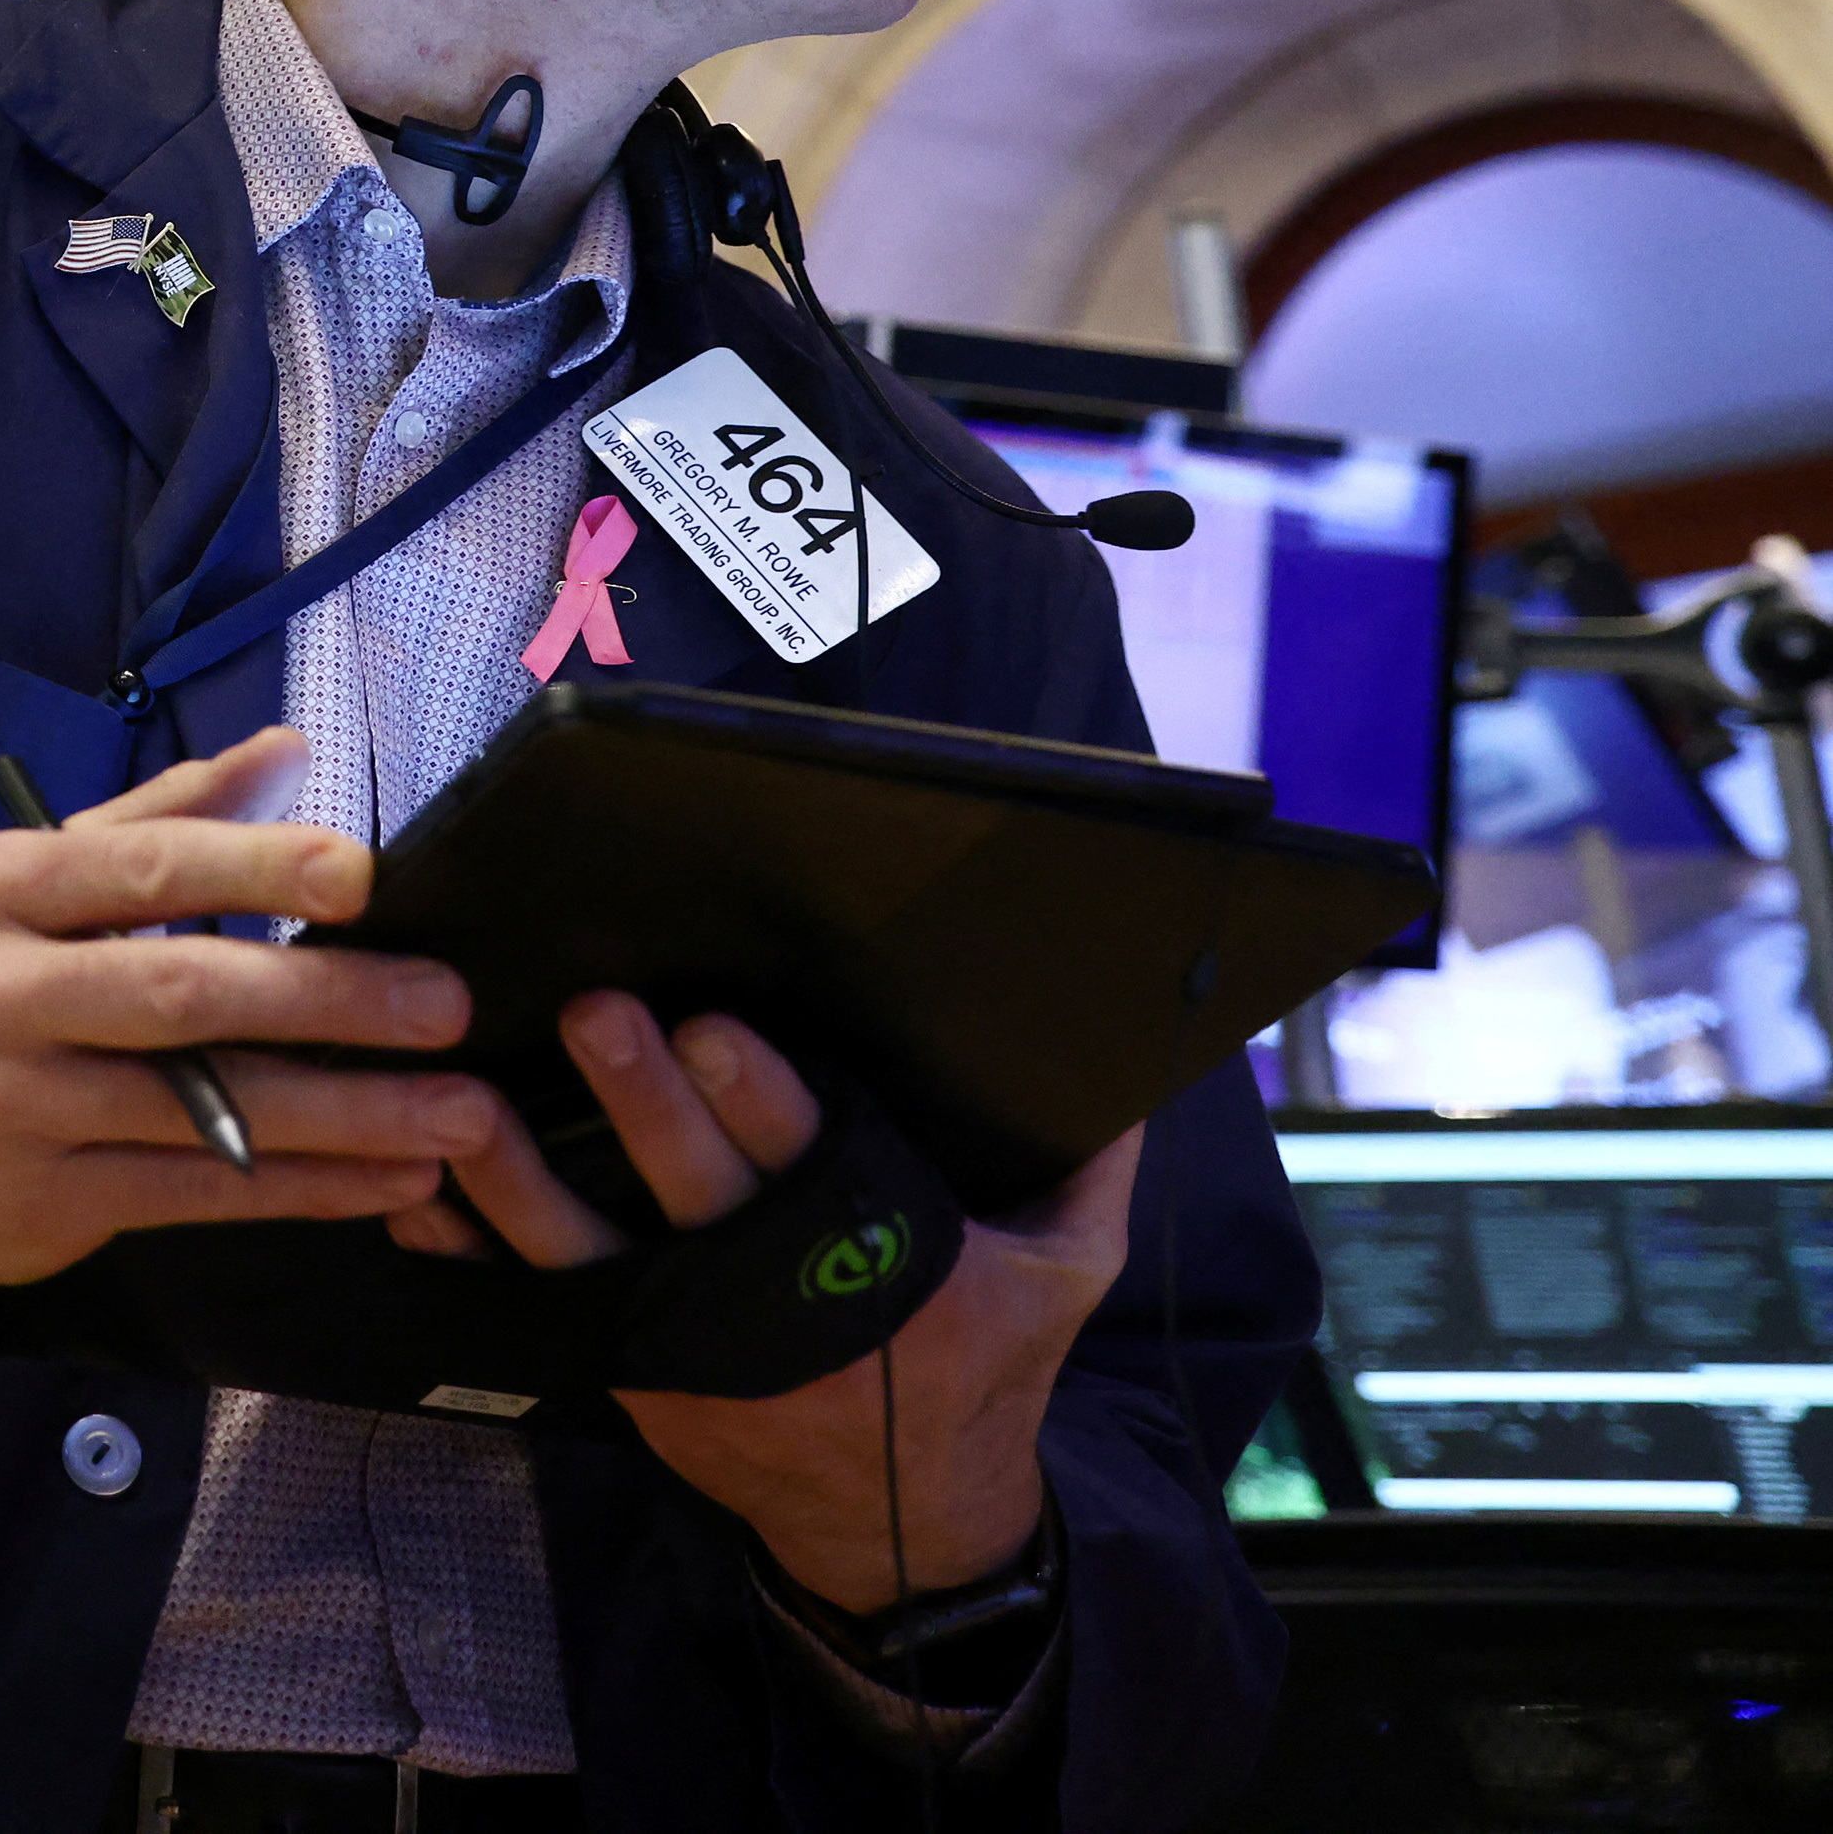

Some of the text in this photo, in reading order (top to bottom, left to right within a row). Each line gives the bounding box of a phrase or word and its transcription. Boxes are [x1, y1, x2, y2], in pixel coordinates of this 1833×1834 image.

[153, 263, 178, 299] NYSE
[589, 419, 674, 505] LIVERMORE
[668, 502, 732, 569] TRADING
[774, 621, 806, 655] INC.
[653, 429, 820, 603] GREGORY M. ROWE
[713, 423, 858, 557] 464
